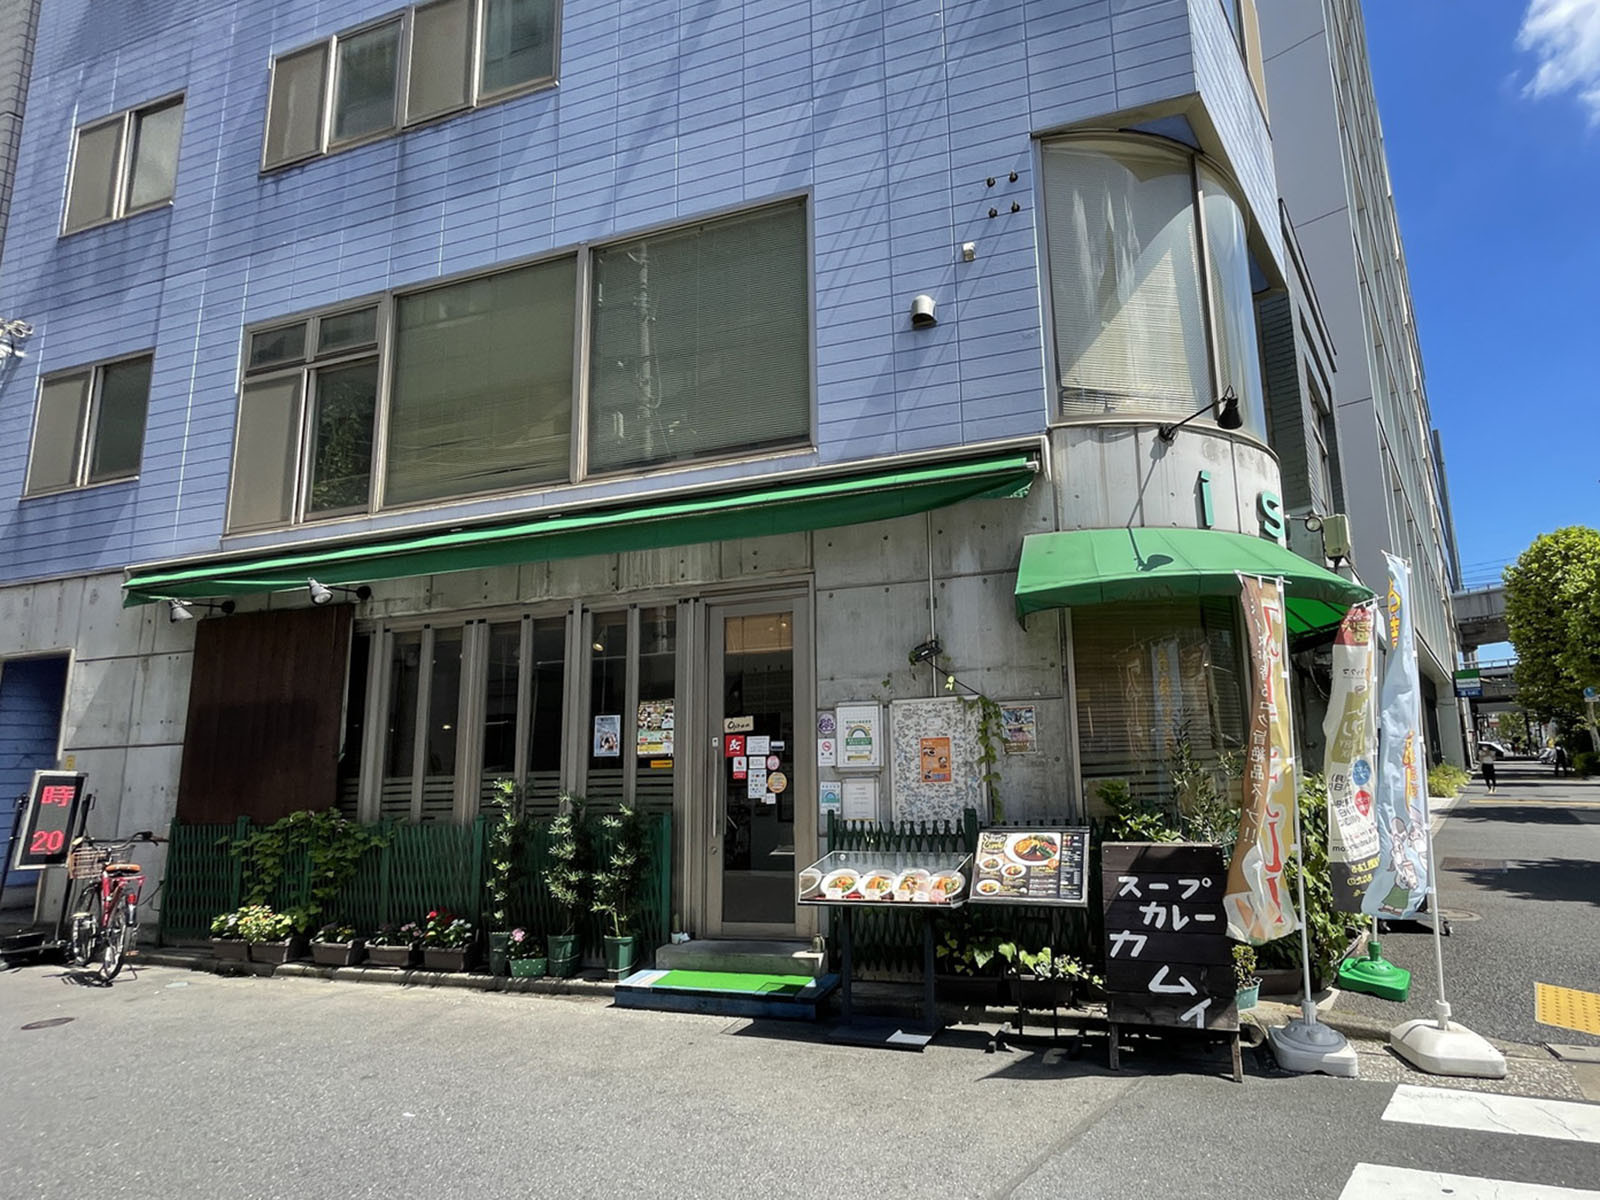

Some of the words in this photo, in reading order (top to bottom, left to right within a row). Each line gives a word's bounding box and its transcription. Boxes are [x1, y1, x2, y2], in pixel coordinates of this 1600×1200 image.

[42, 786, 75, 806] 時
[30, 831, 64, 854] 20
[1117, 875, 1213, 900] スープ
[1138, 901, 1216, 931] カレー
